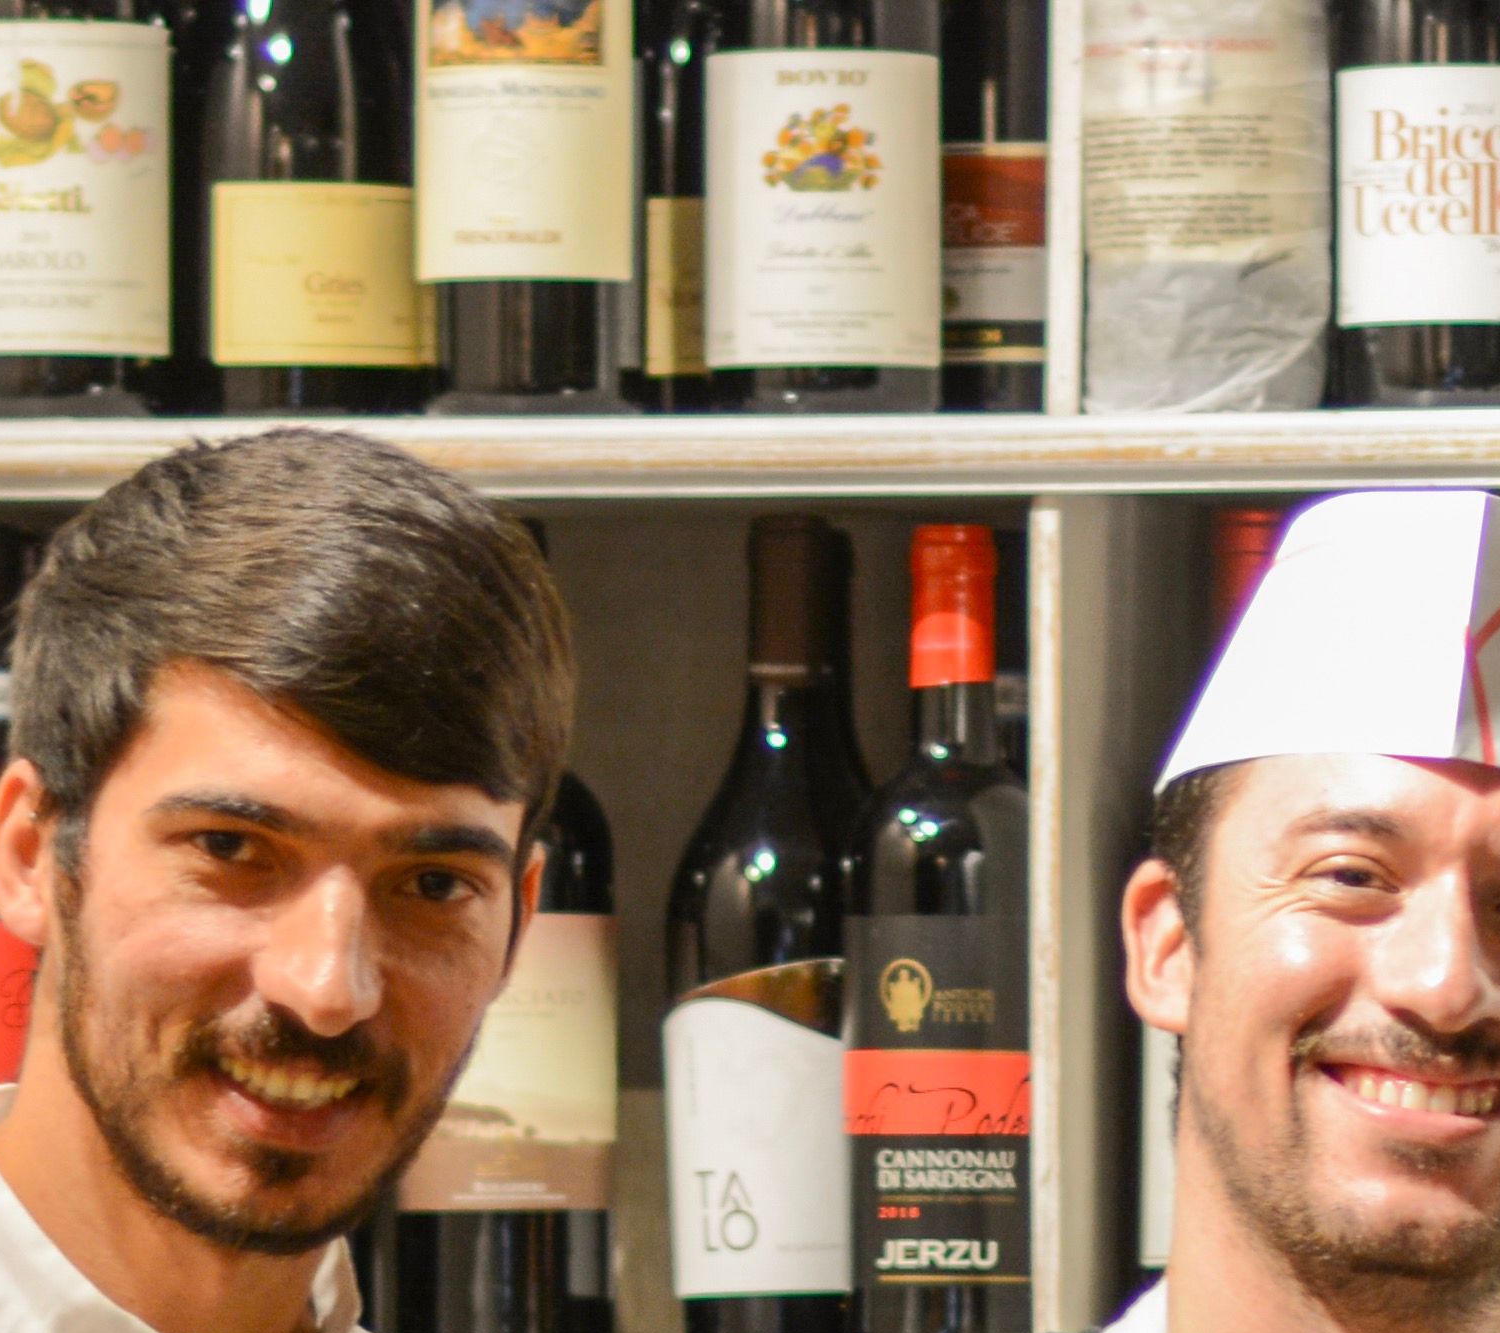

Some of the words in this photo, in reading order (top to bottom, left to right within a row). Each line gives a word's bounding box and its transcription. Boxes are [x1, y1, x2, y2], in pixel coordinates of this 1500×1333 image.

[776, 69, 869, 86] BOVIO
[877, 1150, 1016, 1169] CANNONAU
[877, 1171, 901, 1189] DI
[904, 1170, 1017, 1189] SARDEGNA
[875, 1239, 999, 1269] JERZU
